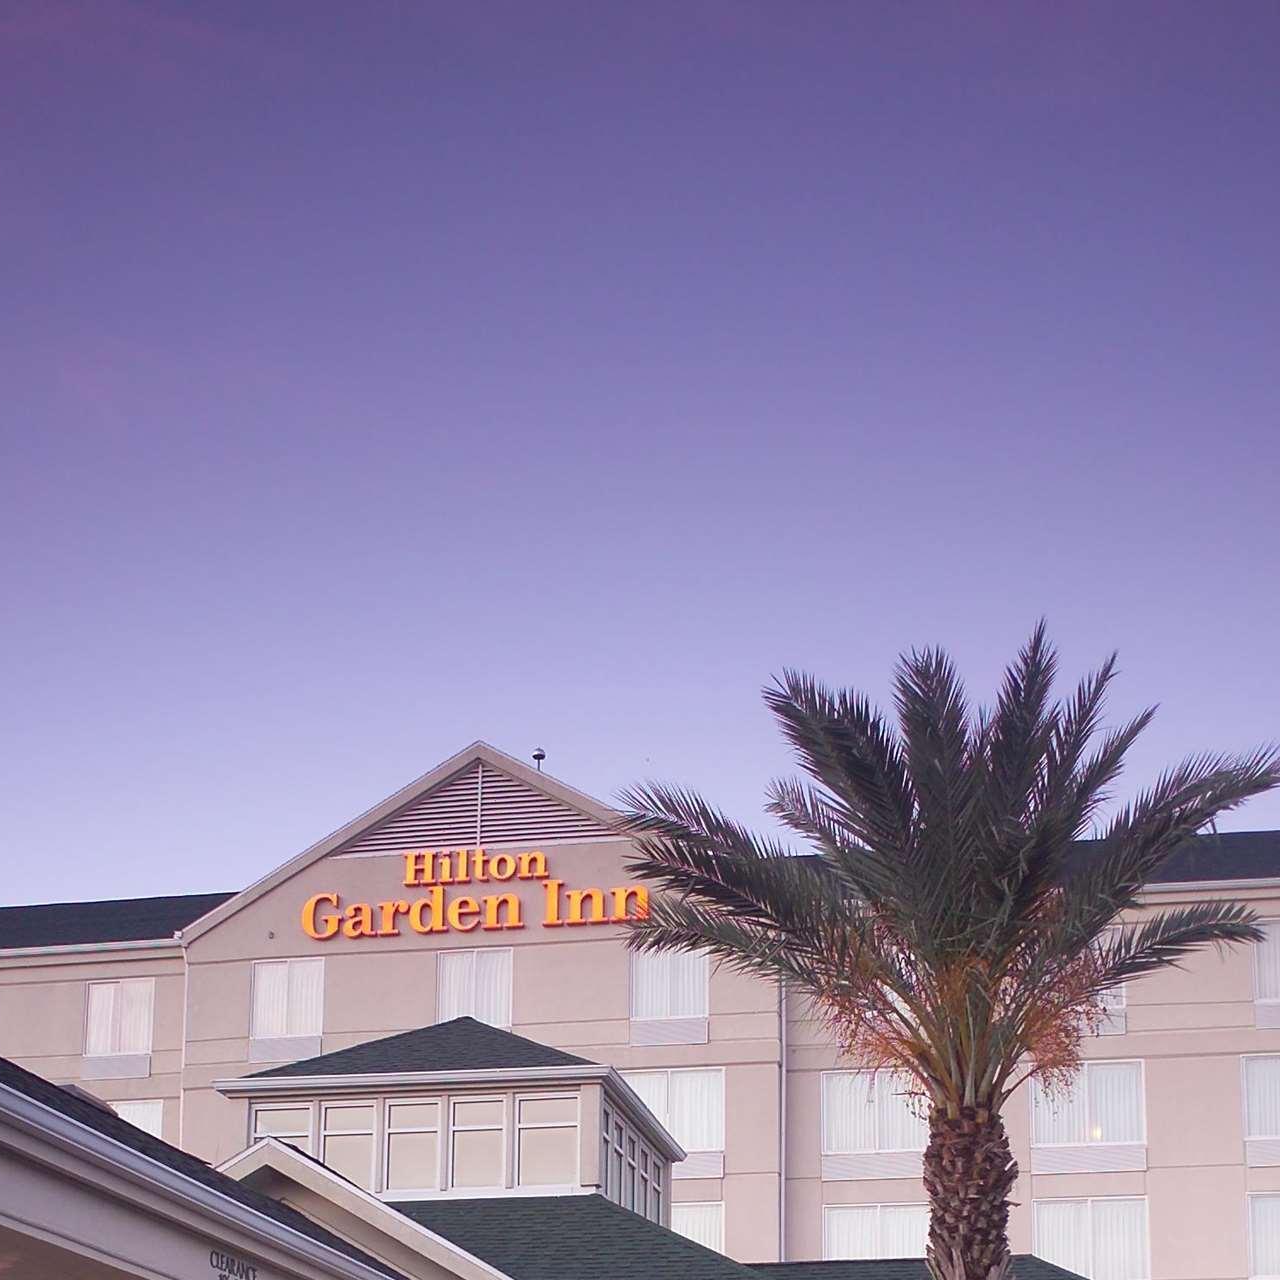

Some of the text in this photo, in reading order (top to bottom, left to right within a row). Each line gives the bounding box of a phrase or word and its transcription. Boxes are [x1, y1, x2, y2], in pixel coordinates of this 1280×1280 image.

[403, 848, 549, 887] Hilton
[301, 879, 650, 940] Garden Inn
